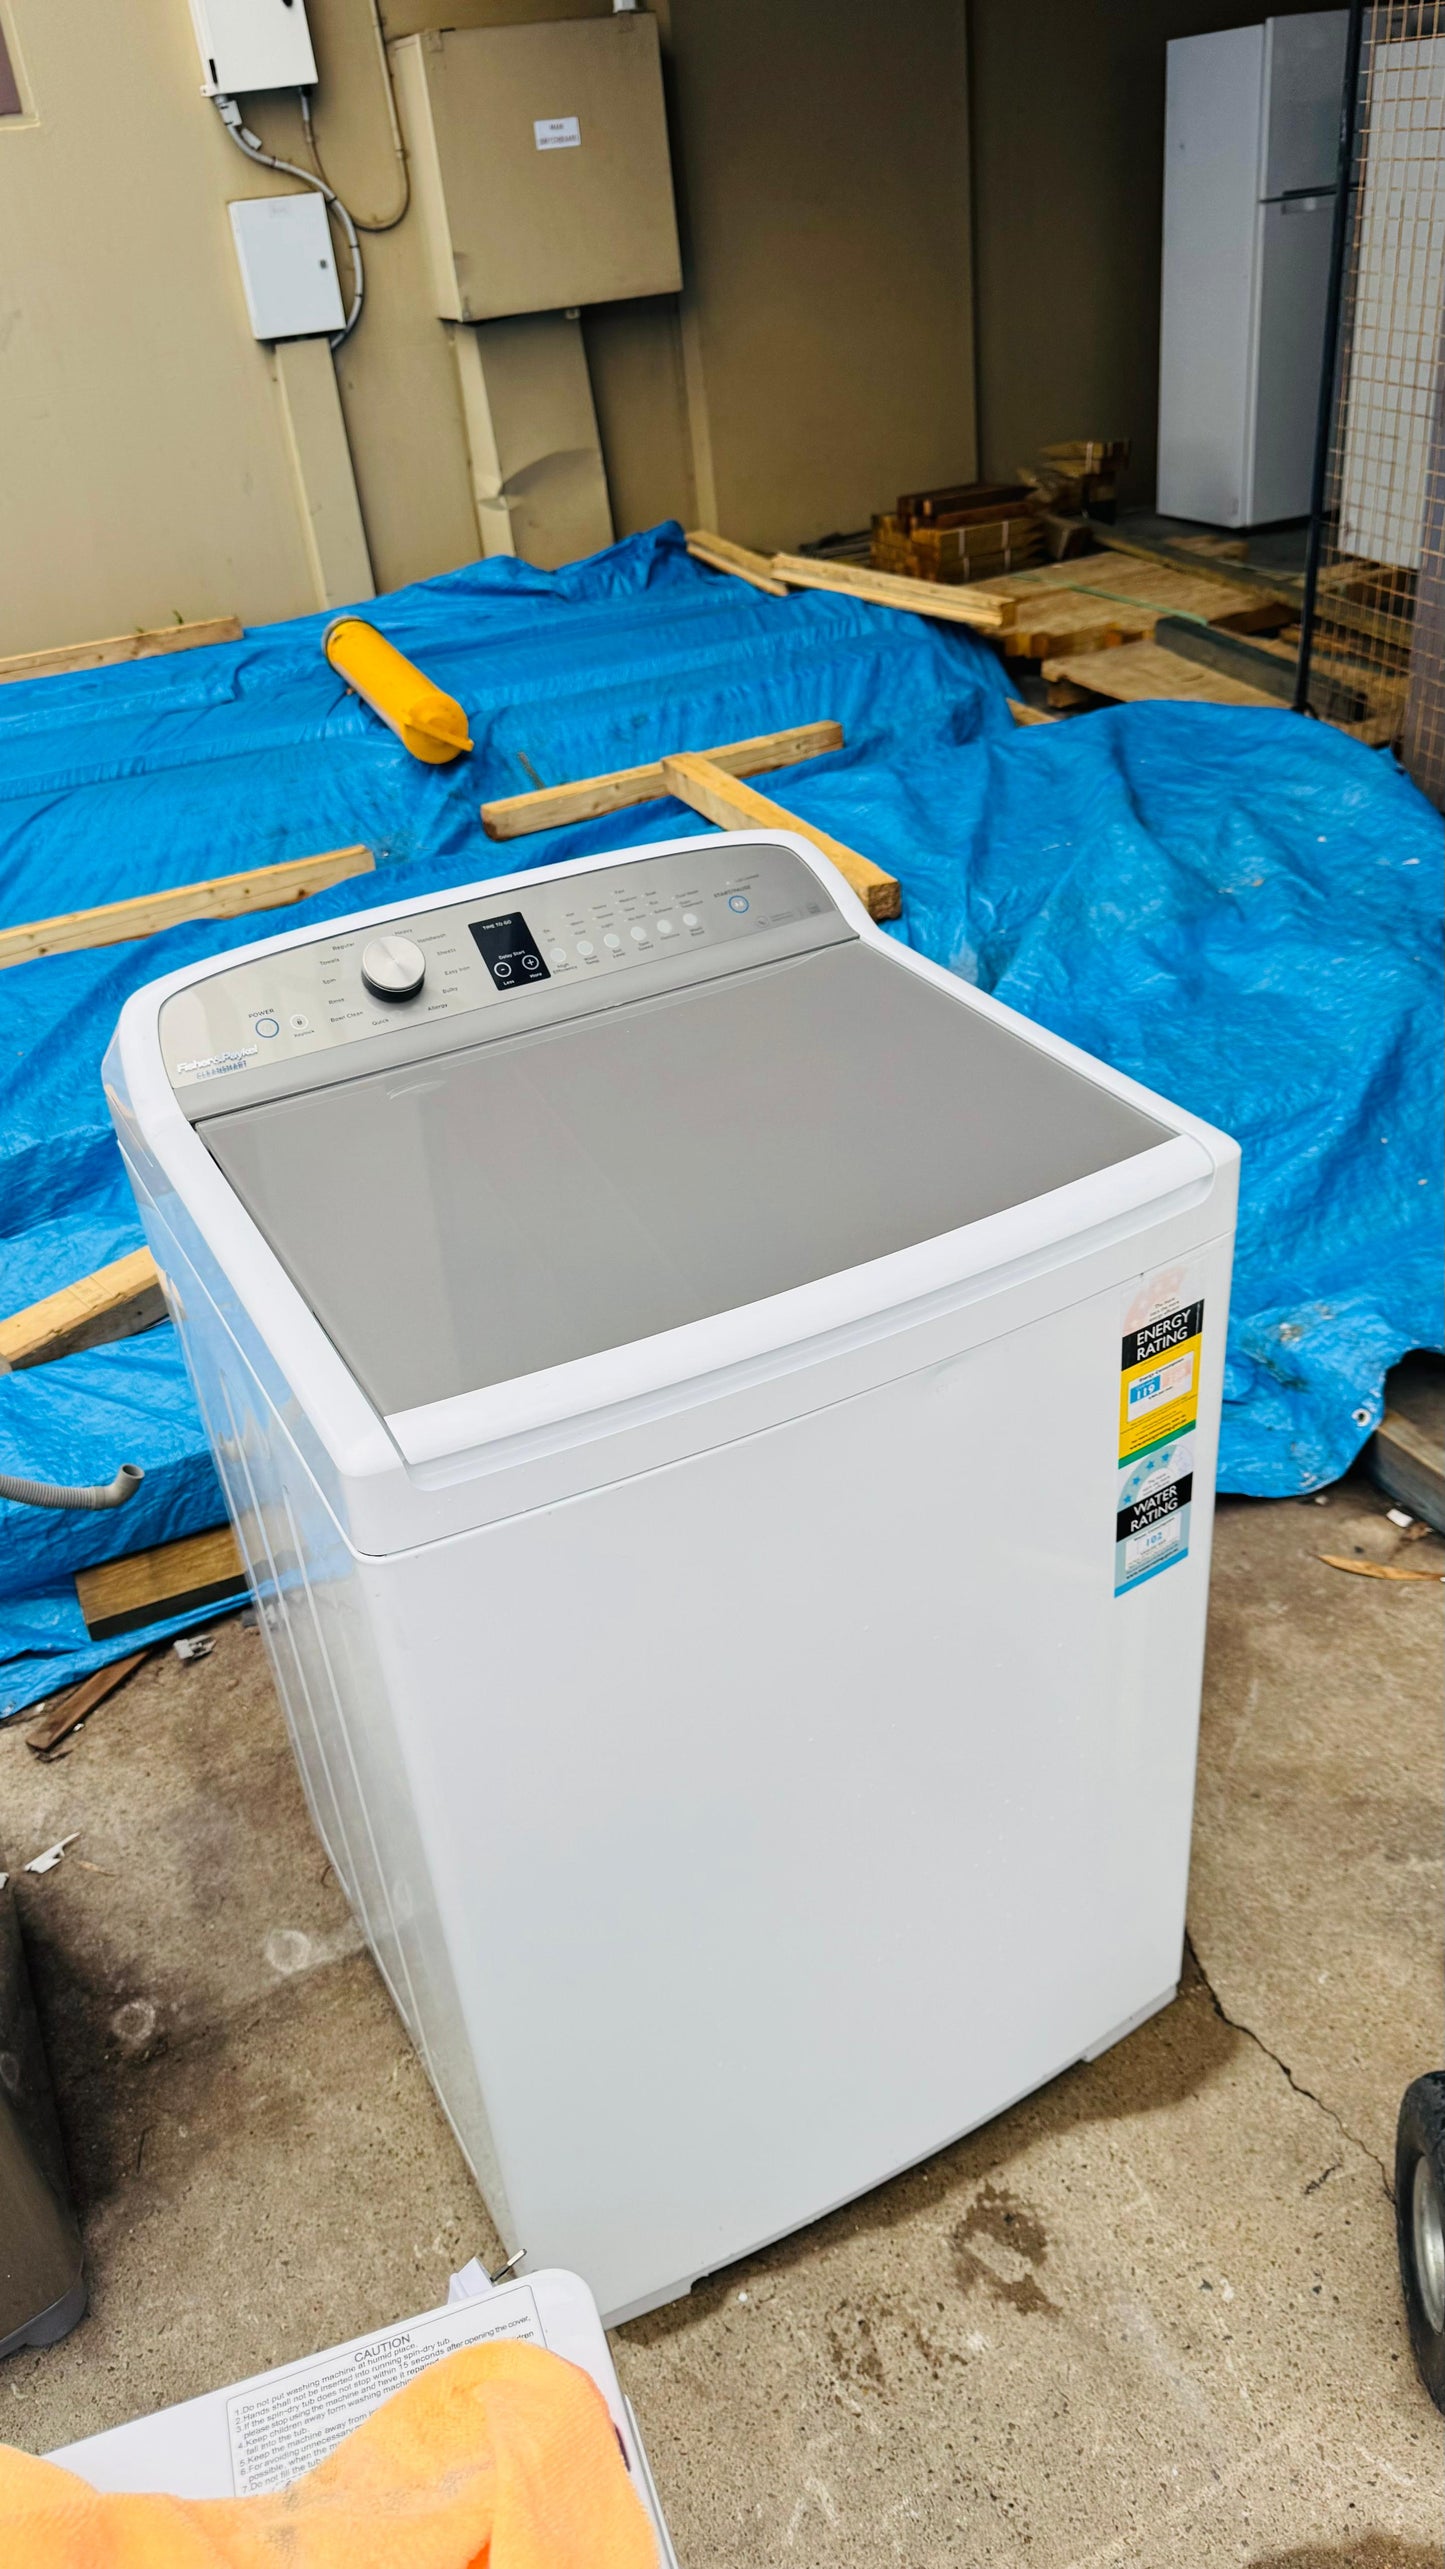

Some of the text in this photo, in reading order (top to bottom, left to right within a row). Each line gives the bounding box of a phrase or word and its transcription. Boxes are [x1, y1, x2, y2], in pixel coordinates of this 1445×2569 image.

[332, 943, 355, 951] Regular
[248, 1008, 275, 1018] POWER
[1136, 1310, 1190, 1346] ENERGY
[1137, 1327, 1188, 1360] RATING
[1137, 1384, 1155, 1400] 119
[1131, 1497, 1178, 1532] RATING
[1133, 1485, 1177, 1515] WATER
[1146, 1532, 1162, 1546] 102
[354, 2334, 410, 2363] CAUTION
[251, 2418, 265, 2427] the
[267, 2405, 300, 2422] spin-dry
[302, 2398, 315, 2408] tub
[317, 2391, 337, 2402] does
[339, 2384, 352, 2394] not
[354, 2377, 371, 2388] stop
[373, 2368, 397, 2380] within
[411, 2349, 445, 2366] seconds
[447, 2341, 463, 2352] after
[464, 2329, 495, 2345] opening
[495, 2325, 507, 2333] the
[508, 2316, 531, 2328] cover,
[256, 2398, 270, 2408] not
[272, 2393, 285, 2404] put
[286, 2380, 320, 2397] washing
[322, 2366, 356, 2383] machine
[367, 2351, 392, 2365] humid
[272, 2398, 291, 2411] shall
[293, 2393, 307, 2403] not
[308, 2389, 319, 2397] be
[321, 2374, 353, 2392] inserted
[355, 2369, 370, 2379] into
[372, 2357, 402, 2372] running
[403, 2344, 436, 2360] spin-dry
[244, 2425, 270, 2440] please
[271, 2418, 288, 2429] stop
[289, 2409, 311, 2421] using
[311, 2404, 324, 2413] the
[325, 2391, 359, 2407] machine
[361, 2382, 376, 2394] and
[378, 2376, 398, 2387] have
[270, 2421, 303, 2438] children
[304, 2413, 325, 2425] away
[327, 2404, 344, 2415] form
[347, 2390, 382, 2407] washing
[246, 2428, 307, 2455] fall into the tub.
[265, 2449, 300, 2467] avoiding
[301, 2428, 354, 2452] unnecessary
[272, 2446, 285, 2454] the
[287, 2431, 322, 2448] machine
[325, 2422, 346, 2434] away
[348, 2414, 367, 2425] from
[288, 2453, 311, 2466] when
[313, 2447, 327, 2456] the
[265, 2474, 279, 2485] not
[280, 2469, 290, 2478] fill
[292, 2465, 305, 2474] the
